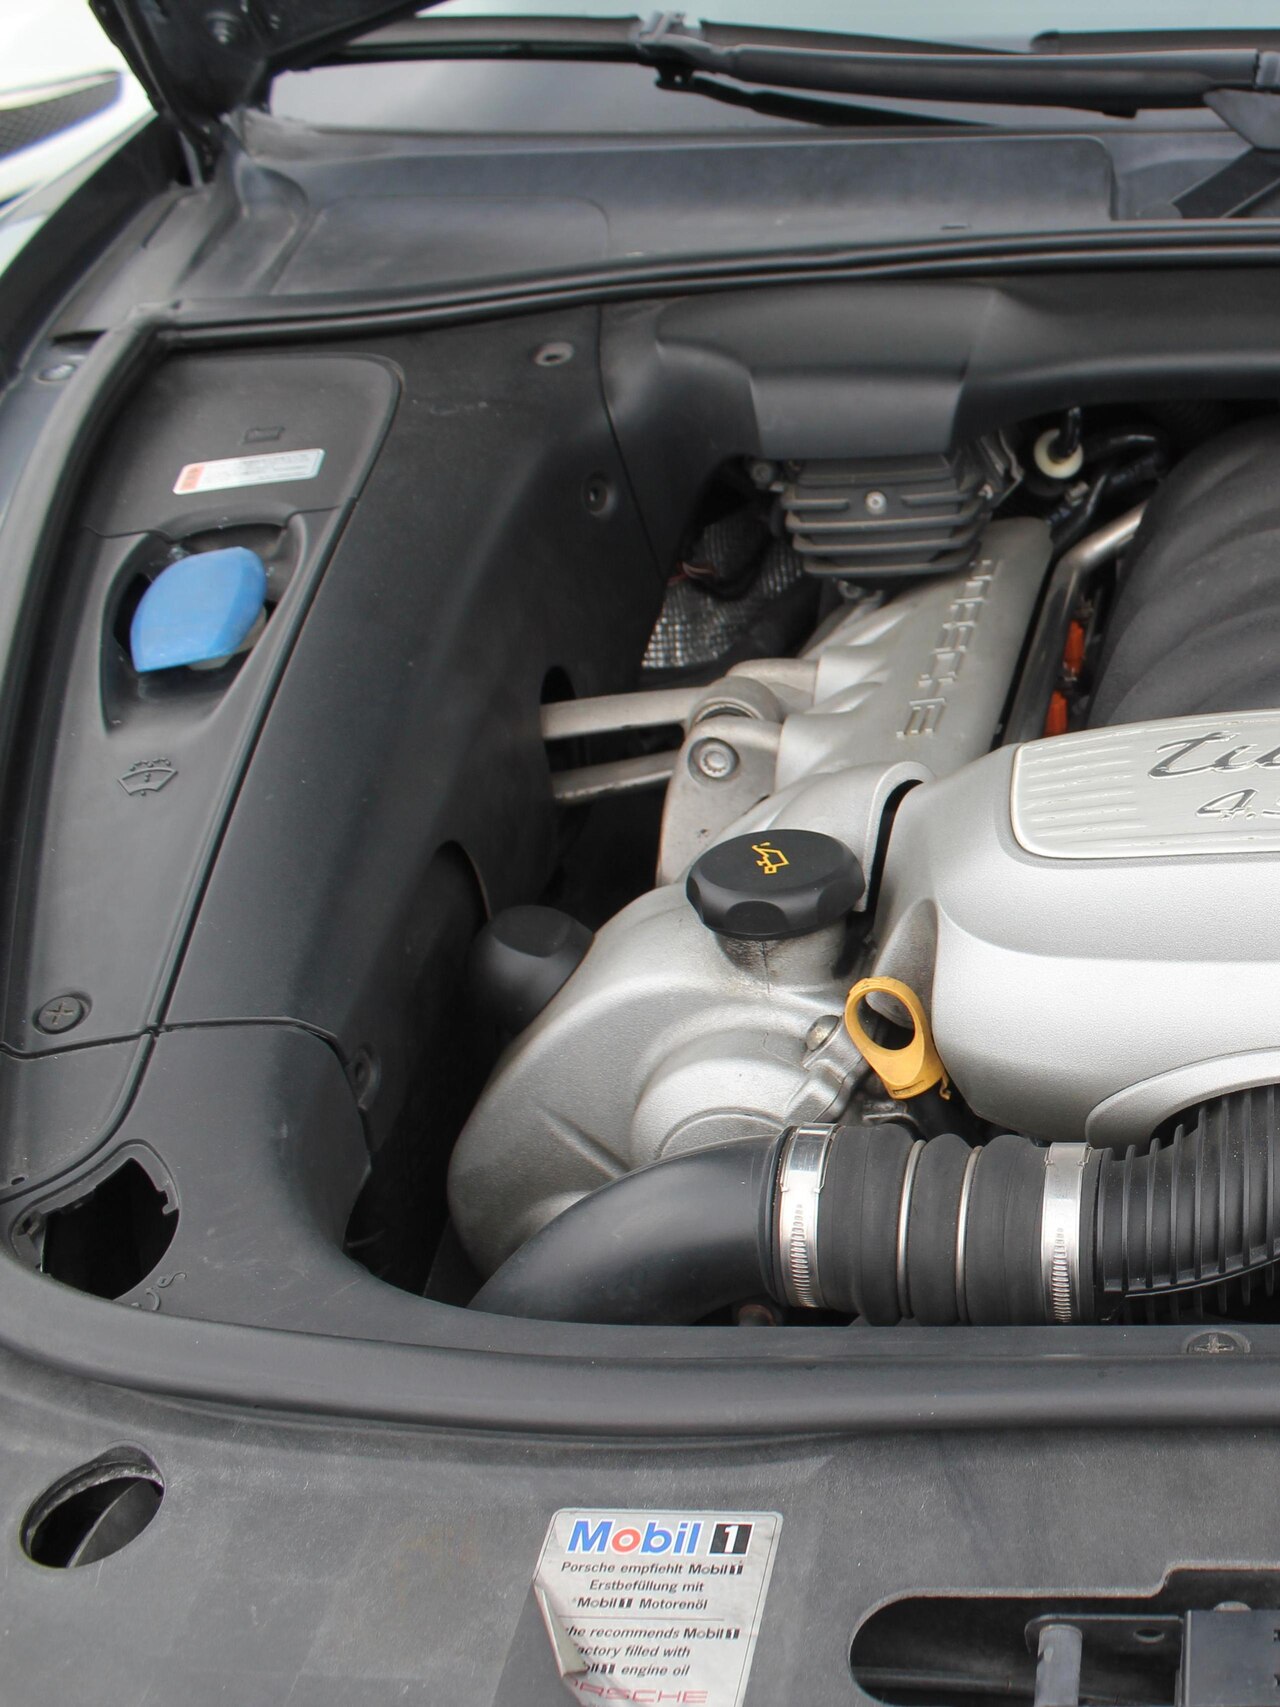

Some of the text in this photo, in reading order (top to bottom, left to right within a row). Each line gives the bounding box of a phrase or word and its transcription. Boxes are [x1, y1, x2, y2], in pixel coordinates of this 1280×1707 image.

[568, 1520, 702, 1554] Mobil
[561, 1562, 615, 1573] Porsche
[620, 1563, 684, 1575] empfiehlt
[589, 1580, 704, 1593] Erstbefüllung mit
[638, 1599, 708, 1610] Motorenöl
[589, 1628, 679, 1639] recommends
[624, 1645, 659, 1657] filled
[663, 1646, 691, 1657] with
[621, 1665, 667, 1677] engine
[673, 1665, 690, 1676] oil
